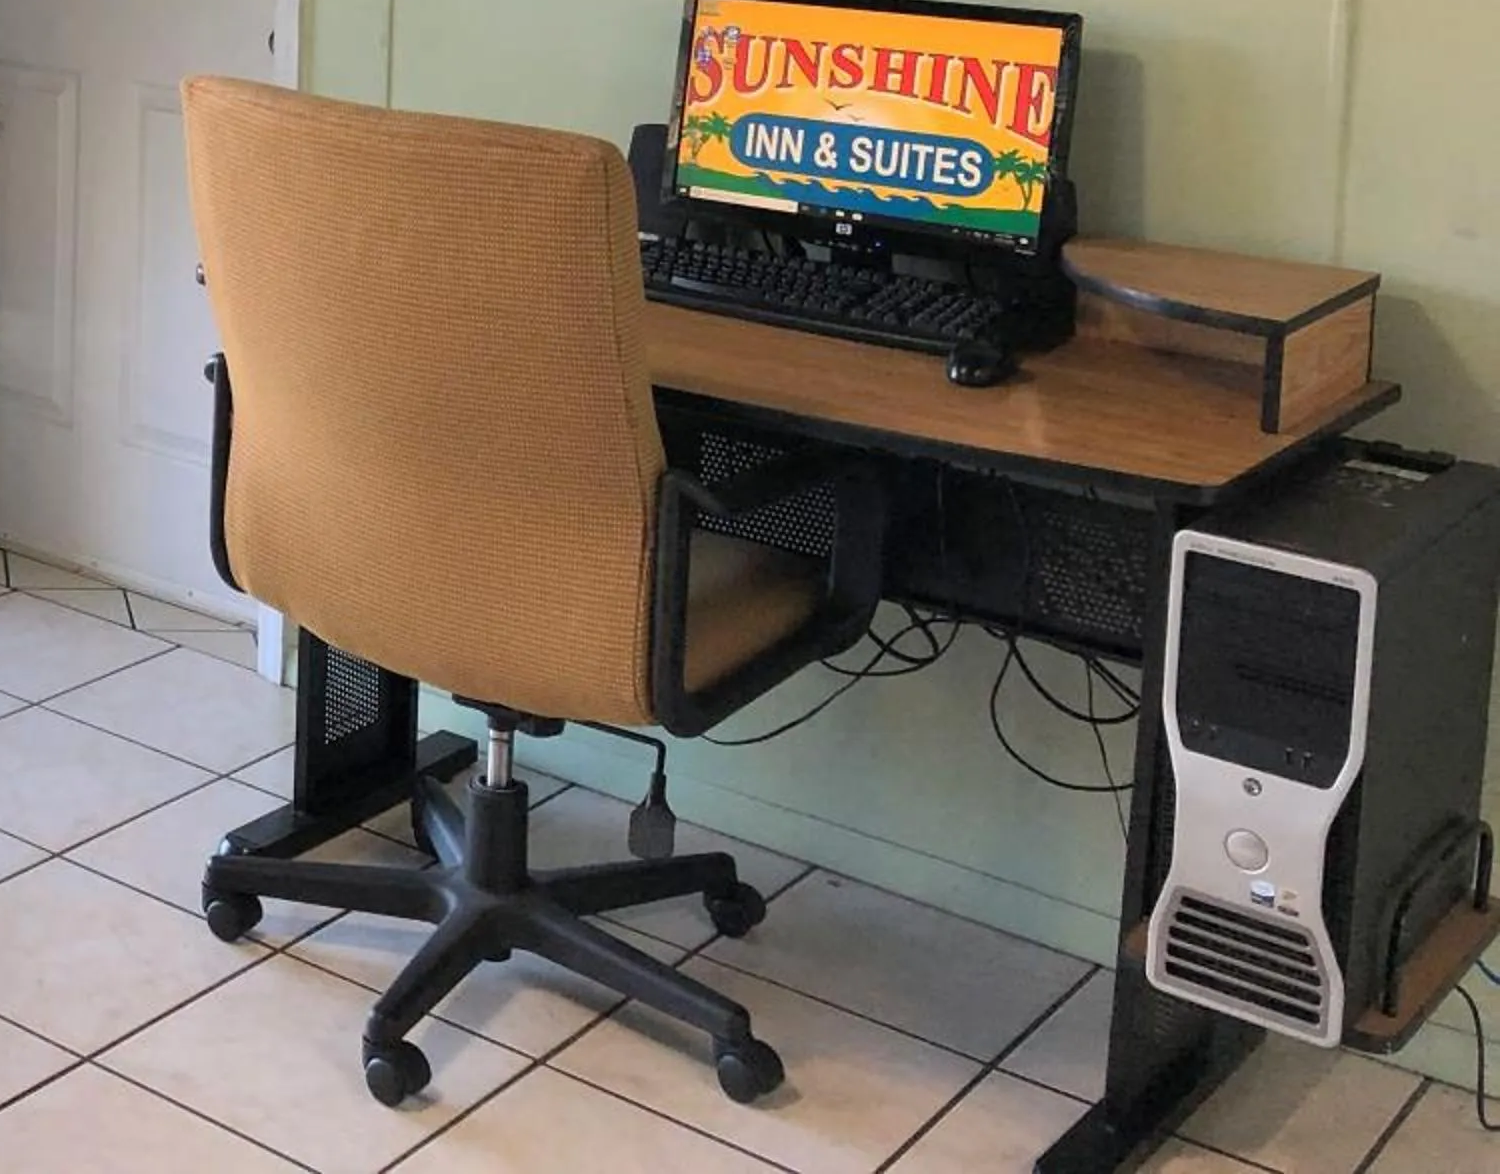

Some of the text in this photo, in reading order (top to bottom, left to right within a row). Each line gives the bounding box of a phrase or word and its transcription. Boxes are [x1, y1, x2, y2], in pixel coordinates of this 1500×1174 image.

[688, 28, 1057, 147] SUNSHINE
[745, 124, 983, 189] INN & SUITES
